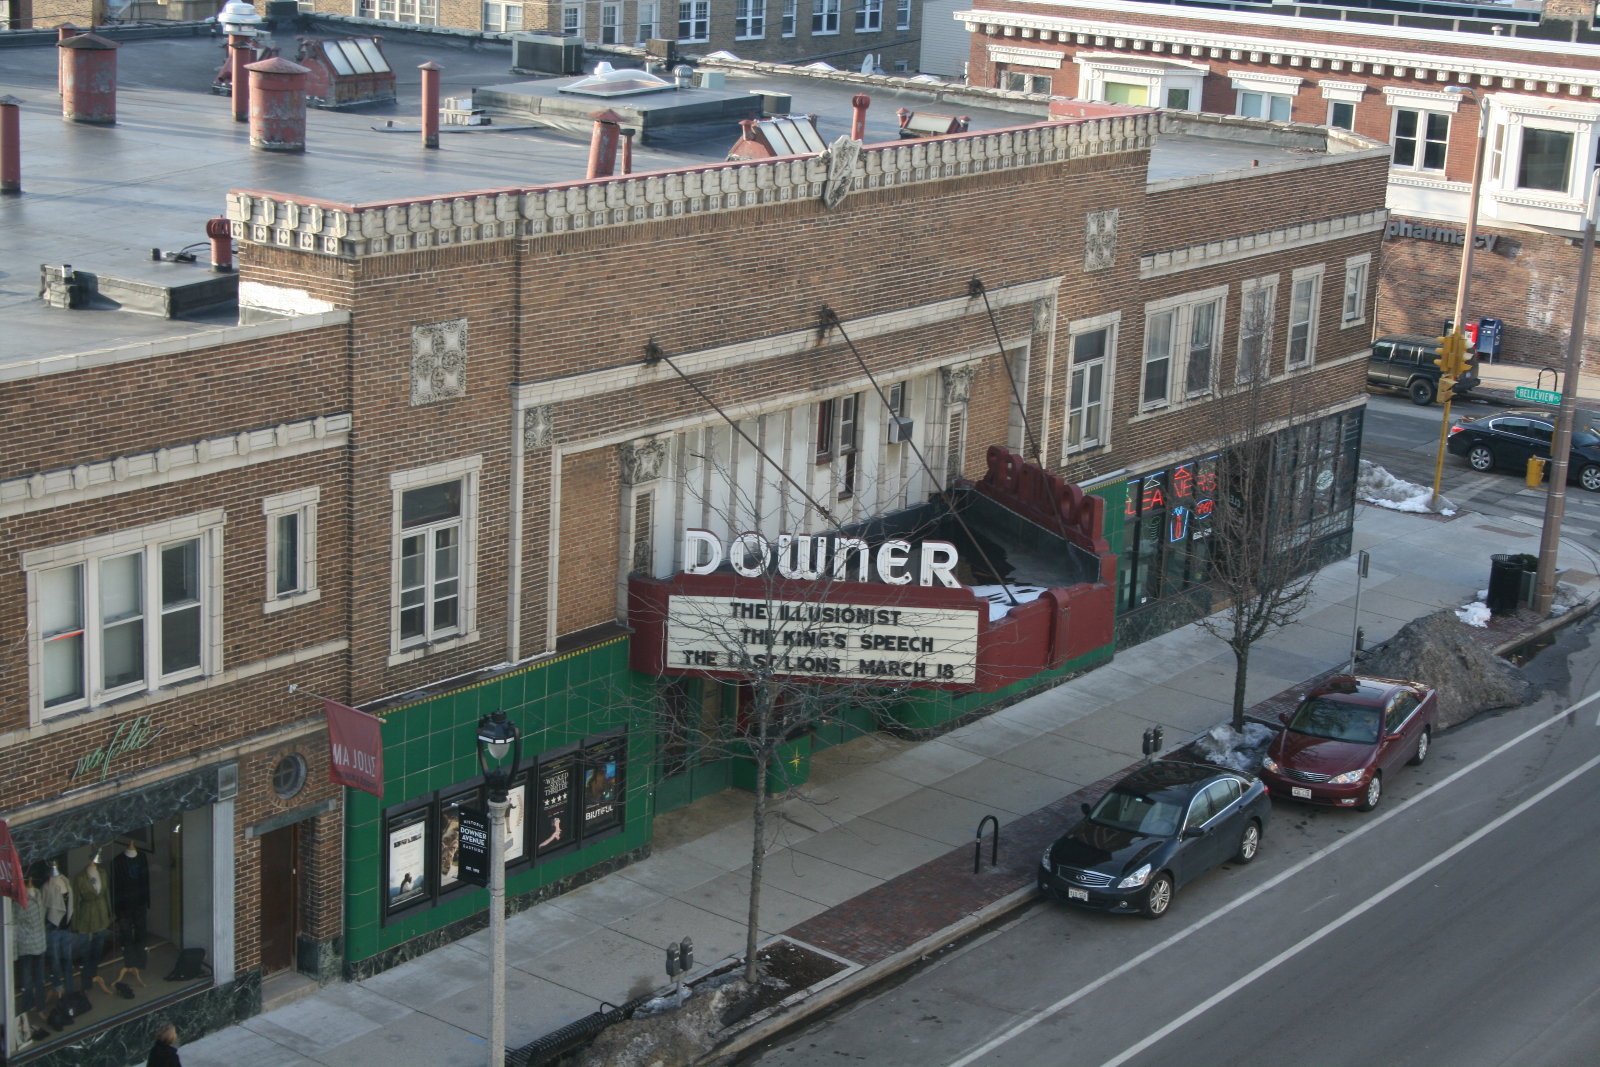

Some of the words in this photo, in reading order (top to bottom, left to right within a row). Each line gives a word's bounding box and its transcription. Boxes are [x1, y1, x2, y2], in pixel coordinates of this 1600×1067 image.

[1385, 218, 1499, 252] pharmacy
[1519, 388, 1555, 402] BELLEVIEW
[684, 528, 962, 589] DOWNER
[730, 602, 768, 619] THE
[780, 605, 901, 626] ILLUSIONIST
[740, 628, 774, 645] THE
[784, 630, 847, 648] KING'S
[860, 634, 934, 653] SPEECH
[683, 650, 717, 667] THE
[728, 653, 776, 669] LAST
[785, 655, 841, 673] LIONS
[859, 659, 926, 678] MARCH
[937, 664, 955, 680] 18
[332, 743, 350, 766] MA
[460, 827, 487, 840] DOWNER
[464, 820, 484, 829] HISTORIC
[461, 834, 485, 846] AVENUE
